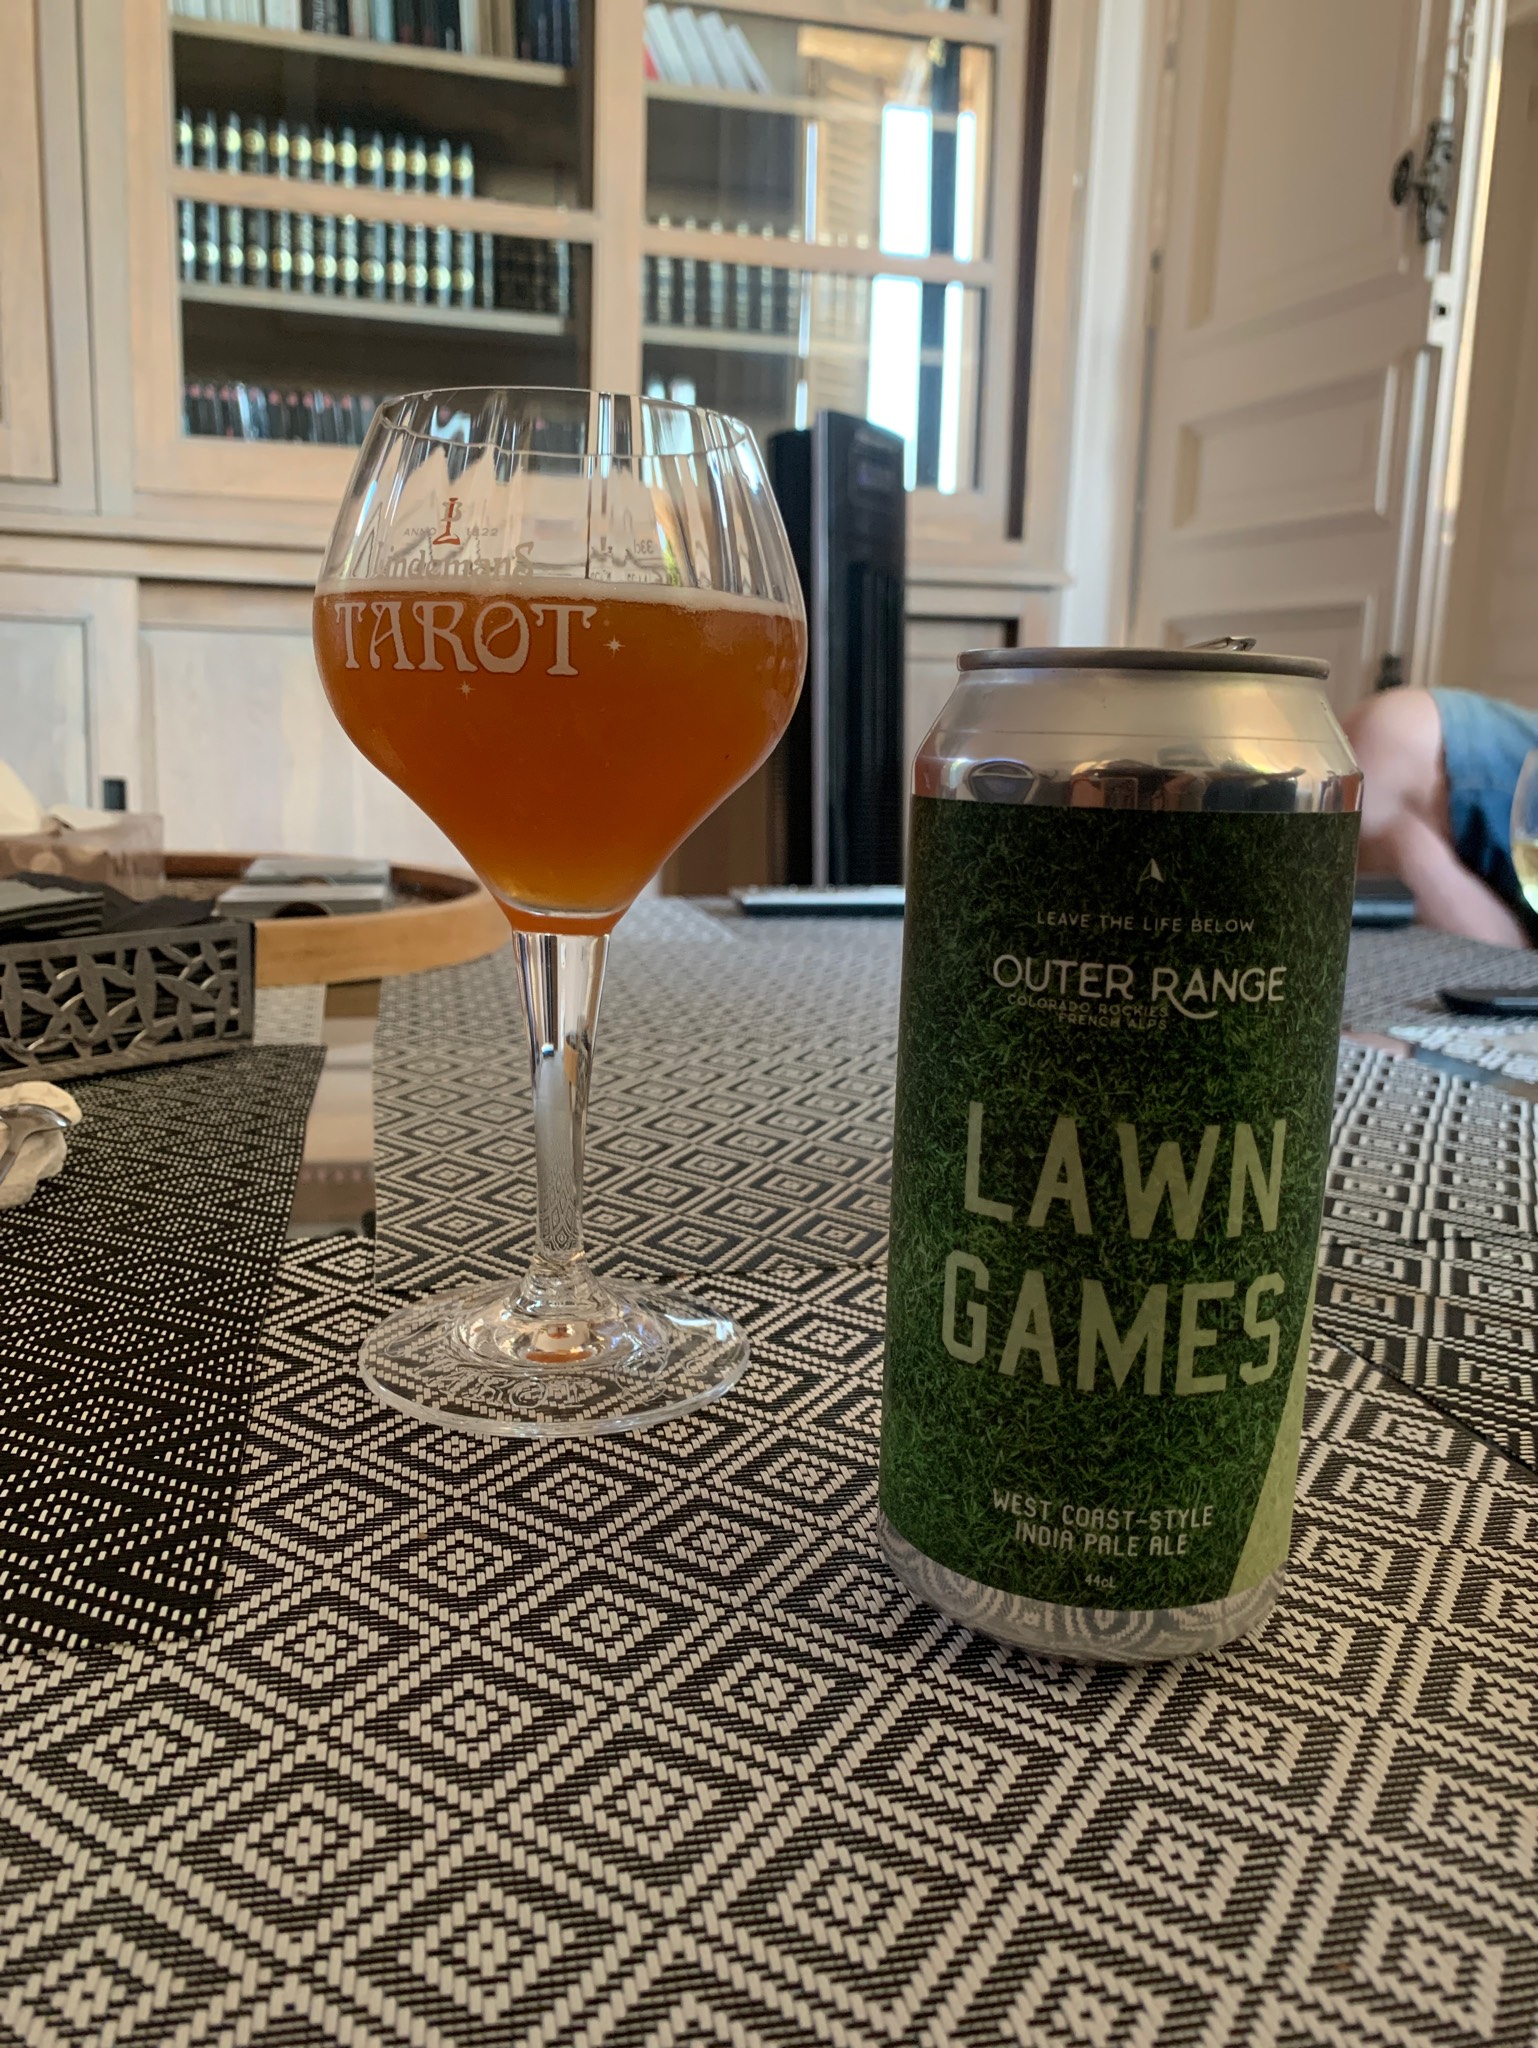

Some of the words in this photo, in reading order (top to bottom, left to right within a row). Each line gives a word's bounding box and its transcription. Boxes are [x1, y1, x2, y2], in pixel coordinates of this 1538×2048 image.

[403, 527, 437, 537] ANNO
[466, 527, 499, 537] 1822
[335, 601, 598, 676] TAROT
[1037, 911, 1091, 928] LEAVE
[1099, 914, 1134, 931] THE
[1142, 918, 1183, 932] LIFE
[1191, 918, 1255, 933] BELOW
[992, 954, 1135, 1000] OUTER
[1152, 966, 1288, 1020] RANGE
[1007, 994, 1091, 1013] COLORADO
[1098, 1003, 1169, 1018] ROCKIES
[1058, 1013, 1121, 1028] FRENCH
[1127, 1018, 1168, 1030] ALPS
[964, 1100, 1287, 1240] LAWN
[941, 1249, 1286, 1396] GAMES
[993, 1488, 1051, 1521] WEST
[1062, 1505, 1214, 1531] COAST-STYLE
[1015, 1520, 1073, 1550] INDIA
[1084, 1532, 1138, 1557] PALE
[1150, 1534, 1188, 1556] ALE
